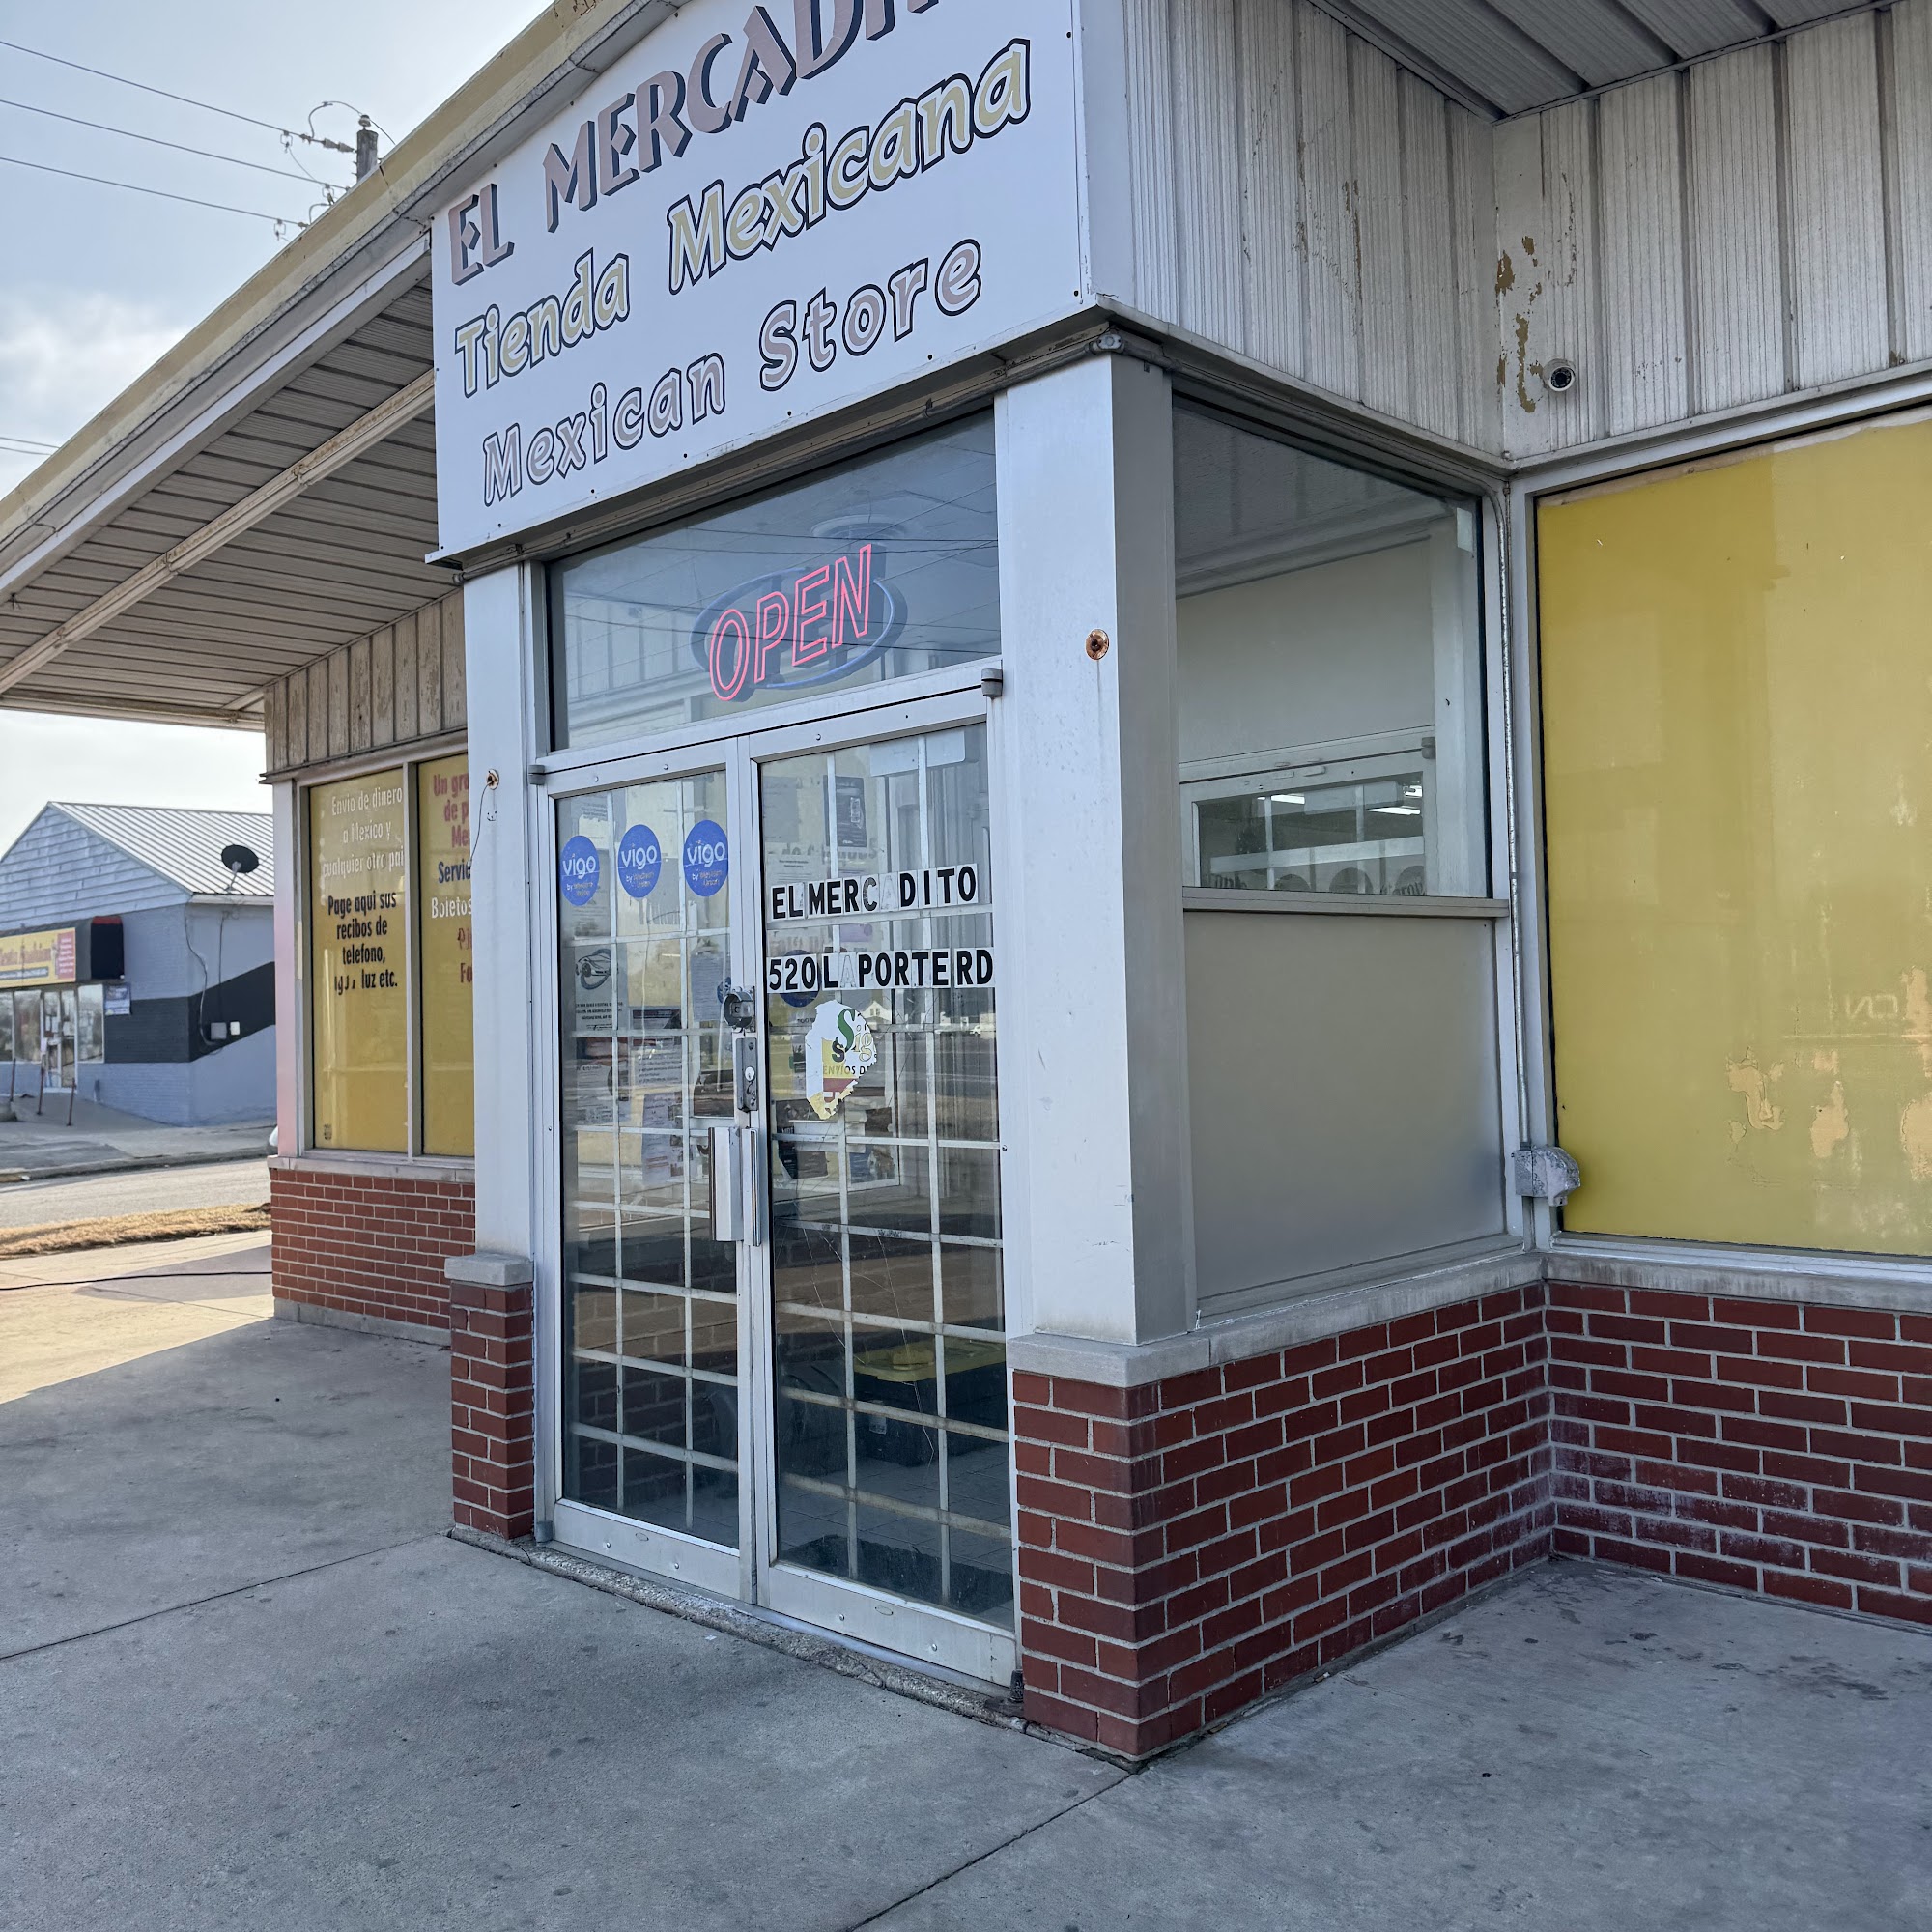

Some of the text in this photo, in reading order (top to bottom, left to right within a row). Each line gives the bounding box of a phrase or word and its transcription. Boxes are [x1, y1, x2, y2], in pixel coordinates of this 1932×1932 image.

[448, 0, 939, 285] EL MERCAD
[455, 38, 1031, 397] Tienda Mexicana
[484, 239, 981, 507] Mexican Store
[709, 544, 871, 701] OPEN
[357, 790, 370, 810] de
[372, 786, 403, 808] dinero
[433, 773, 448, 797] Un
[444, 799, 458, 822] de
[351, 820, 384, 842] Mexico
[322, 853, 364, 879] cualquier
[366, 852, 385, 871] otro
[563, 854, 596, 880] vigo
[620, 843, 658, 870] vigo
[687, 840, 726, 867] vigo
[327, 890, 397, 919] Page aqui sus
[336, 915, 388, 940] recibos de
[361, 969, 377, 989] luz
[379, 969, 398, 988] etc.
[769, 956, 817, 991] 520
[823, 1065, 856, 1075] ENVIOS
